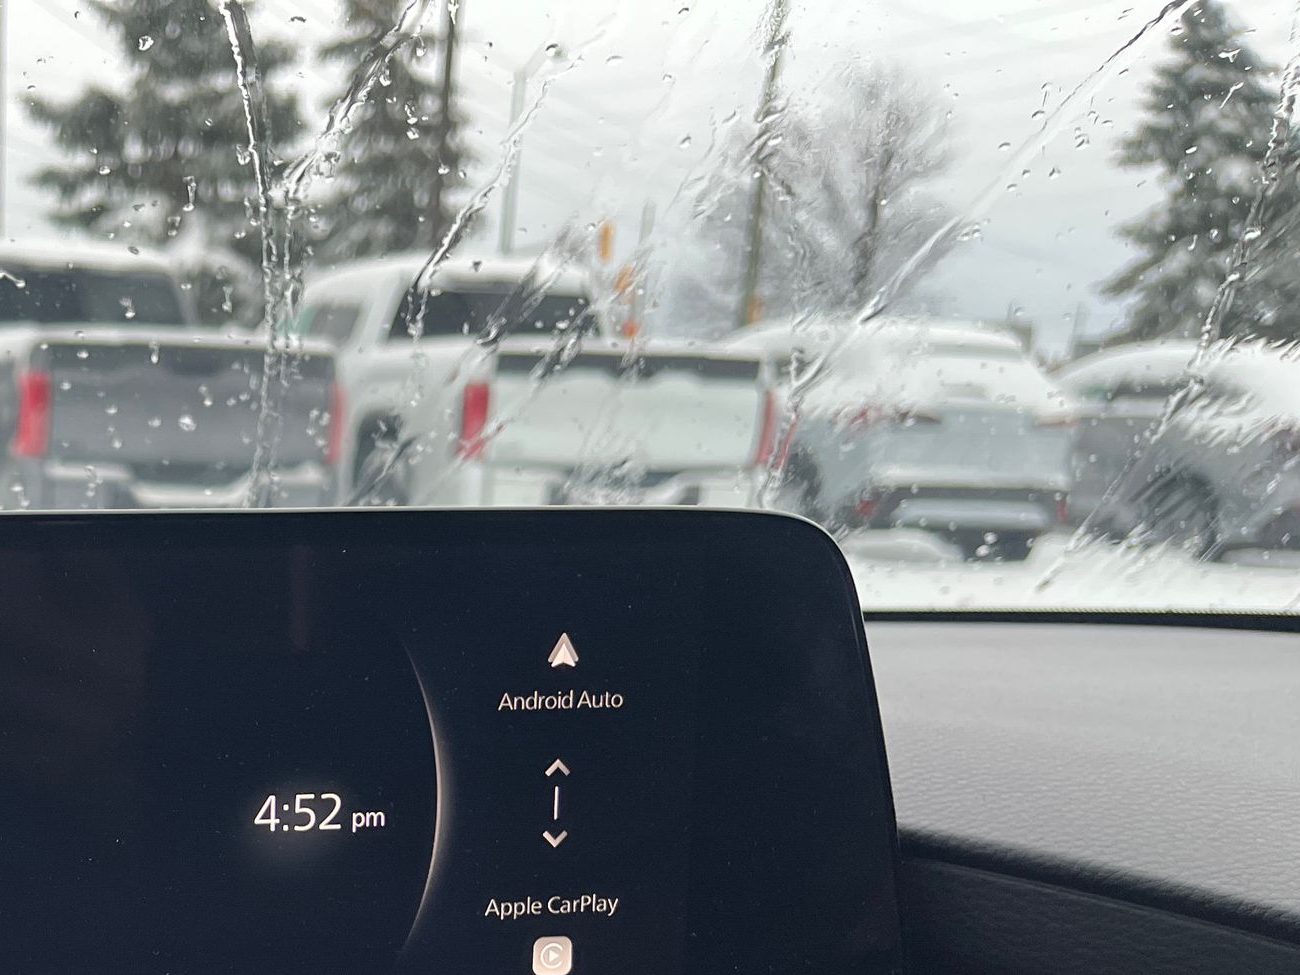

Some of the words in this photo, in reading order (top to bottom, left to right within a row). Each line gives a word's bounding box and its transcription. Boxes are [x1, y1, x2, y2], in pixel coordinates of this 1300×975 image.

[497, 689, 575, 711] Android
[576, 690, 625, 710] Auto
[253, 792, 342, 833] 4:52
[351, 811, 386, 833] pm
[484, 896, 543, 921] Apple
[547, 893, 619, 917] CarPlay
